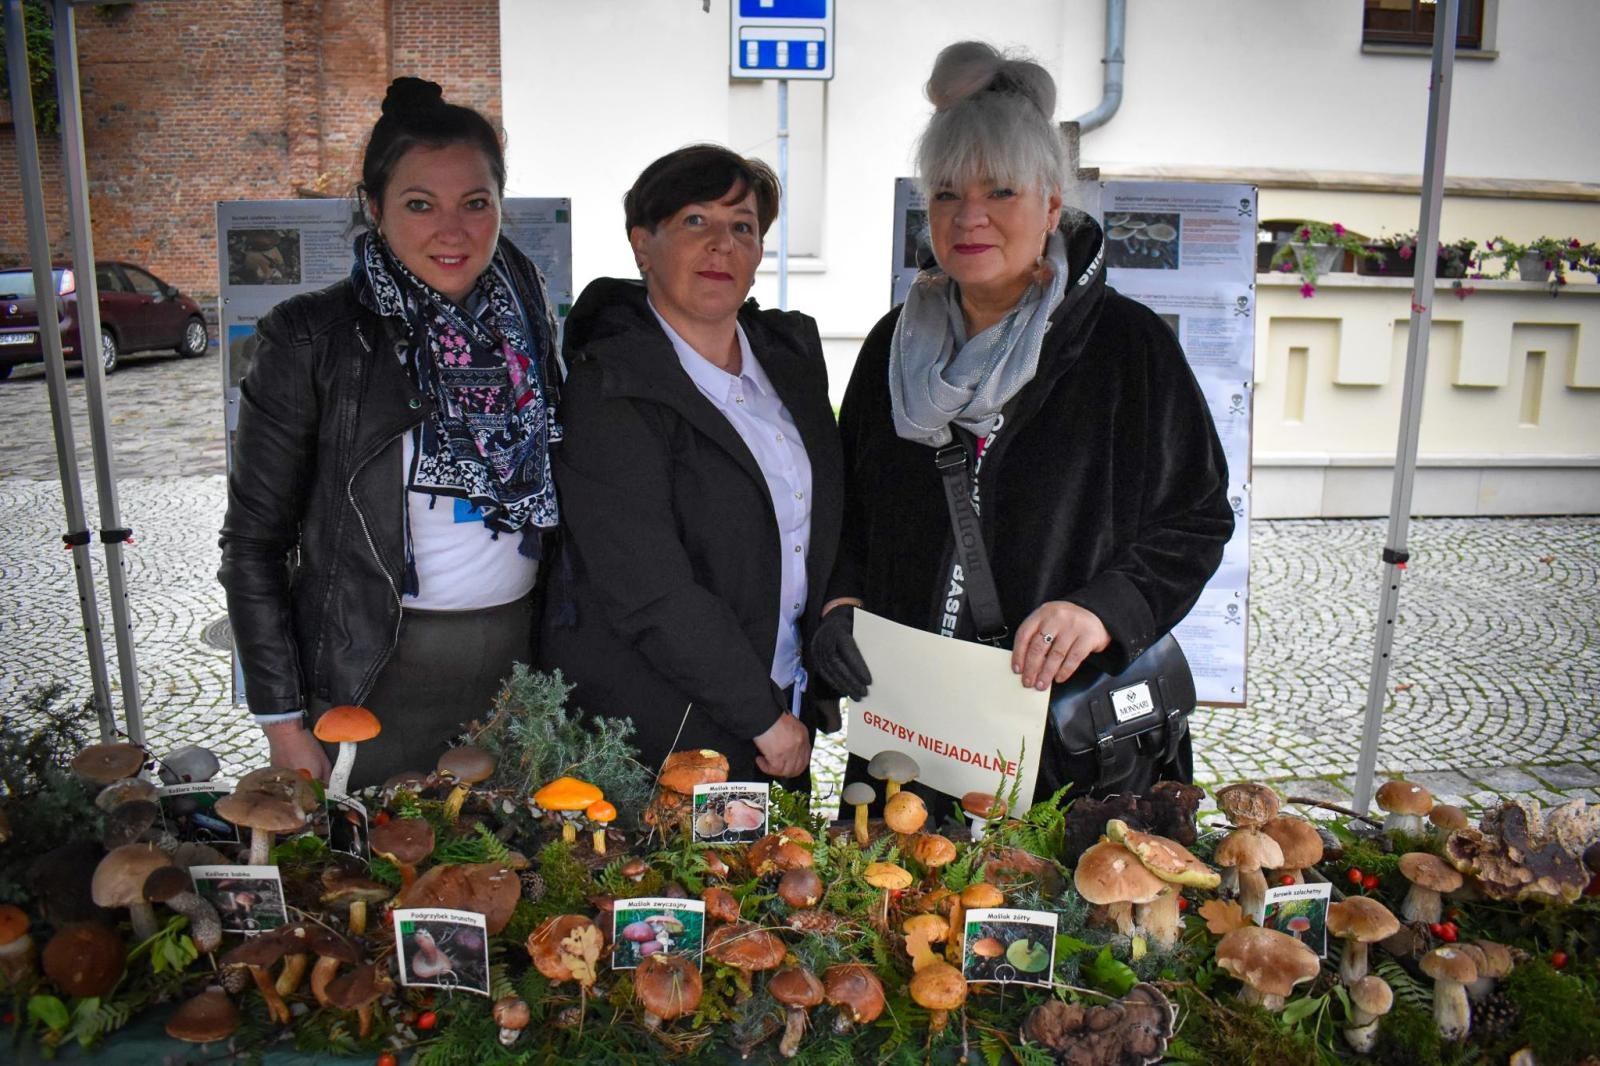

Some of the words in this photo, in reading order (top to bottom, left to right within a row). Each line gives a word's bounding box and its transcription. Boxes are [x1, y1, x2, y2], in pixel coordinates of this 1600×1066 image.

[863, 711, 915, 742] GRZYBY
[917, 733, 1017, 776] NIEJADALNE
[653, 901, 688, 909] zwyczajny
[410, 911, 448, 921] Podgrzybek
[450, 913, 477, 924] brunatny
[987, 912, 1010, 920] Maślak
